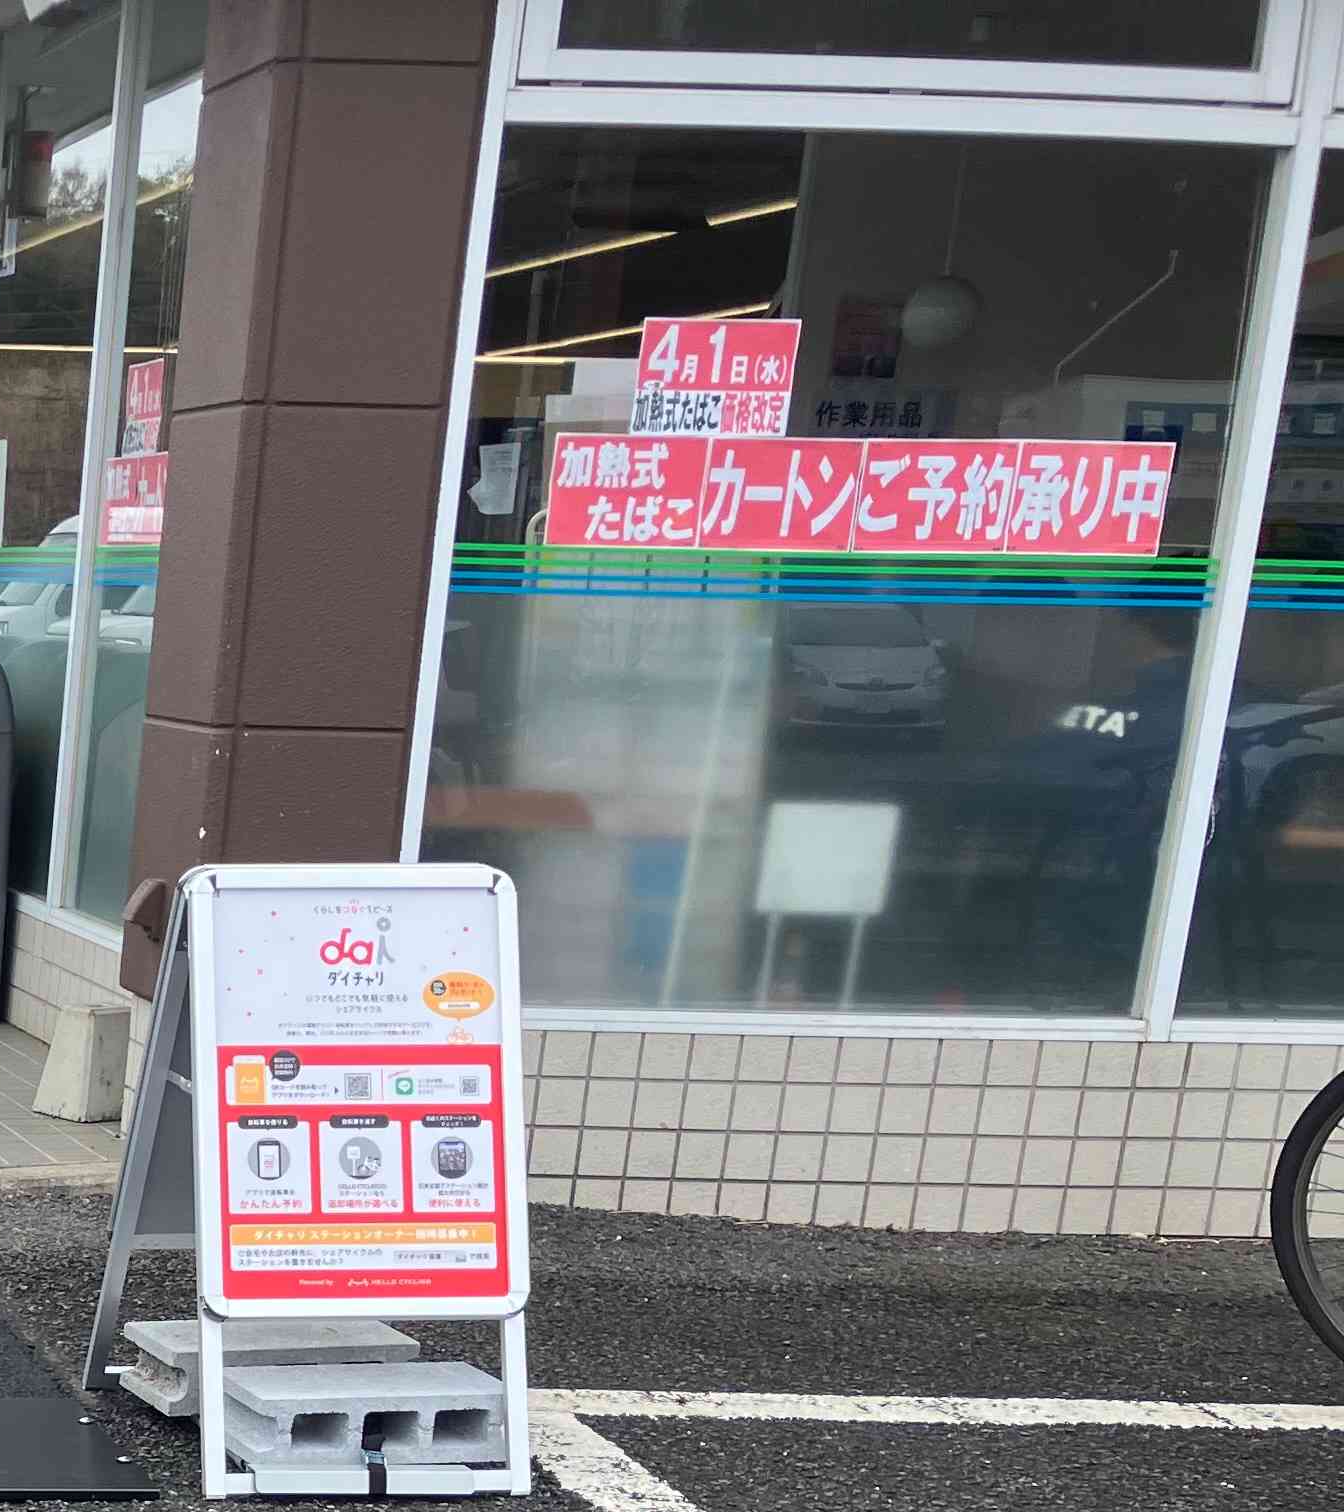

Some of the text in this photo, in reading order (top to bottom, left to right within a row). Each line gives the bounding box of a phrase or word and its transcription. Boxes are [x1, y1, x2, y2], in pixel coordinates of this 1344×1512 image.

[633, 391, 785, 434] 加熱式たばこ価格改定
[816, 401, 923, 428] 作業用品
[557, 443, 669, 490] 加熱式
[584, 495, 694, 542] たばこ
[703, 449, 1169, 543] カートンご予約承り中
[328, 971, 385, 986] ダイチャリ
